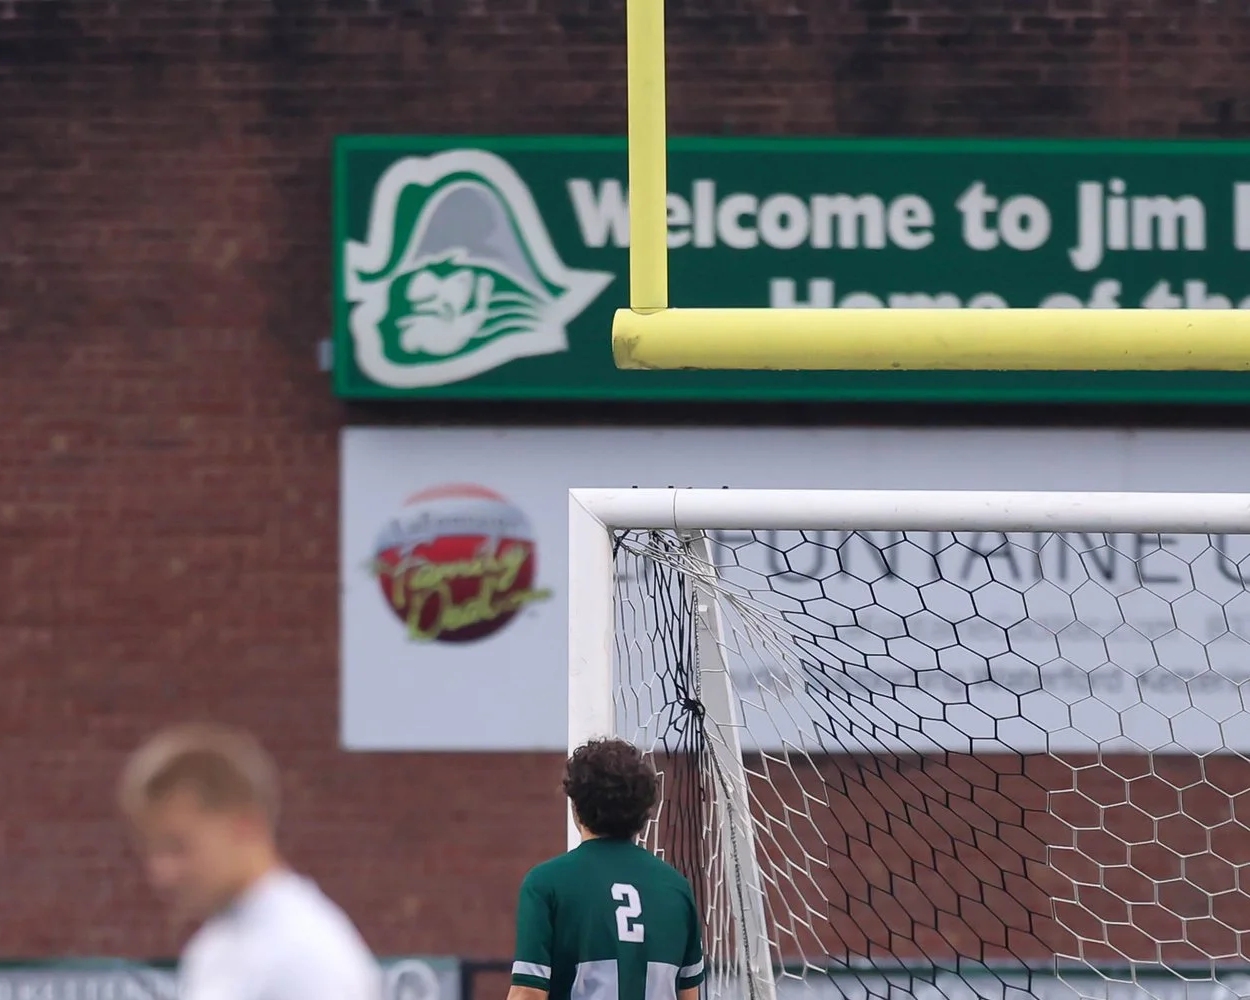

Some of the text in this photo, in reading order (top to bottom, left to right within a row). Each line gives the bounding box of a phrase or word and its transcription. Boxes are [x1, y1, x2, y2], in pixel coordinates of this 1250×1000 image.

[956, 180, 1051, 250] to
[1068, 177, 1206, 271] Jim
[611, 883, 645, 943] 2
